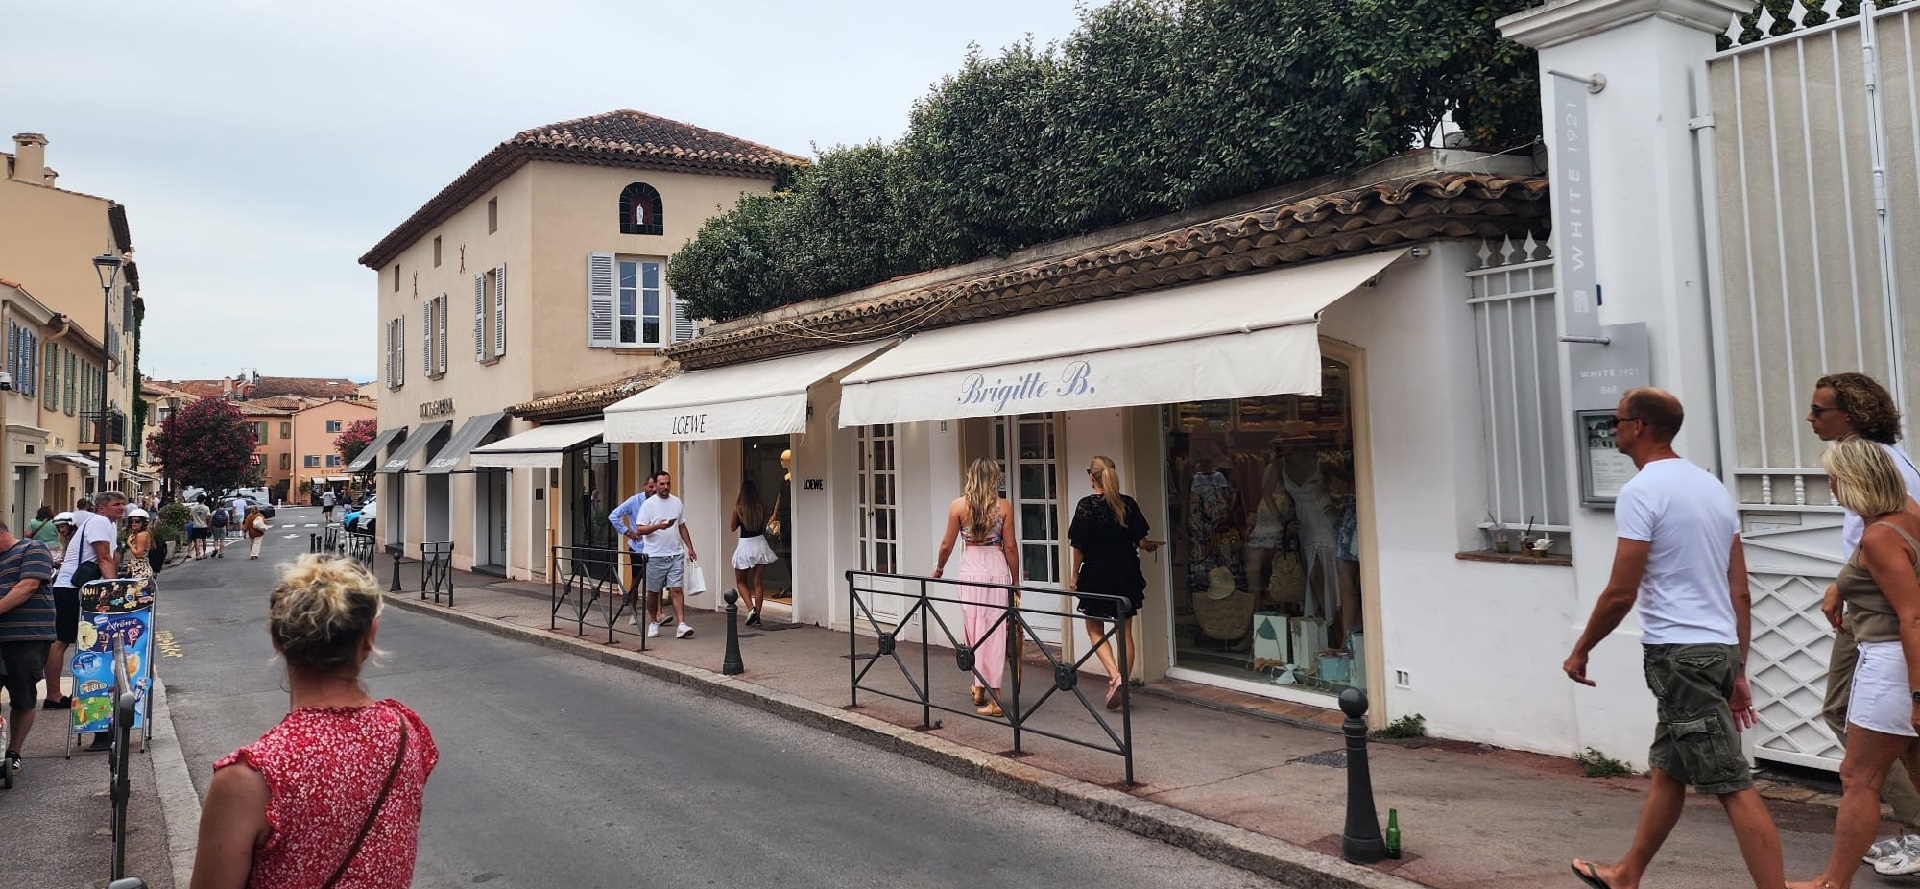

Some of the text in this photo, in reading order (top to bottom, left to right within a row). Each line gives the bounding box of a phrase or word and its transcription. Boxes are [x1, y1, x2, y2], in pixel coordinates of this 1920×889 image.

[1566, 102, 1585, 271] WHITE 1921
[1580, 369, 1615, 378] WHITE
[957, 359, 1095, 413] Brigitte B.
[672, 414, 708, 435] LOEWE
[803, 478, 824, 490] LOEWE
